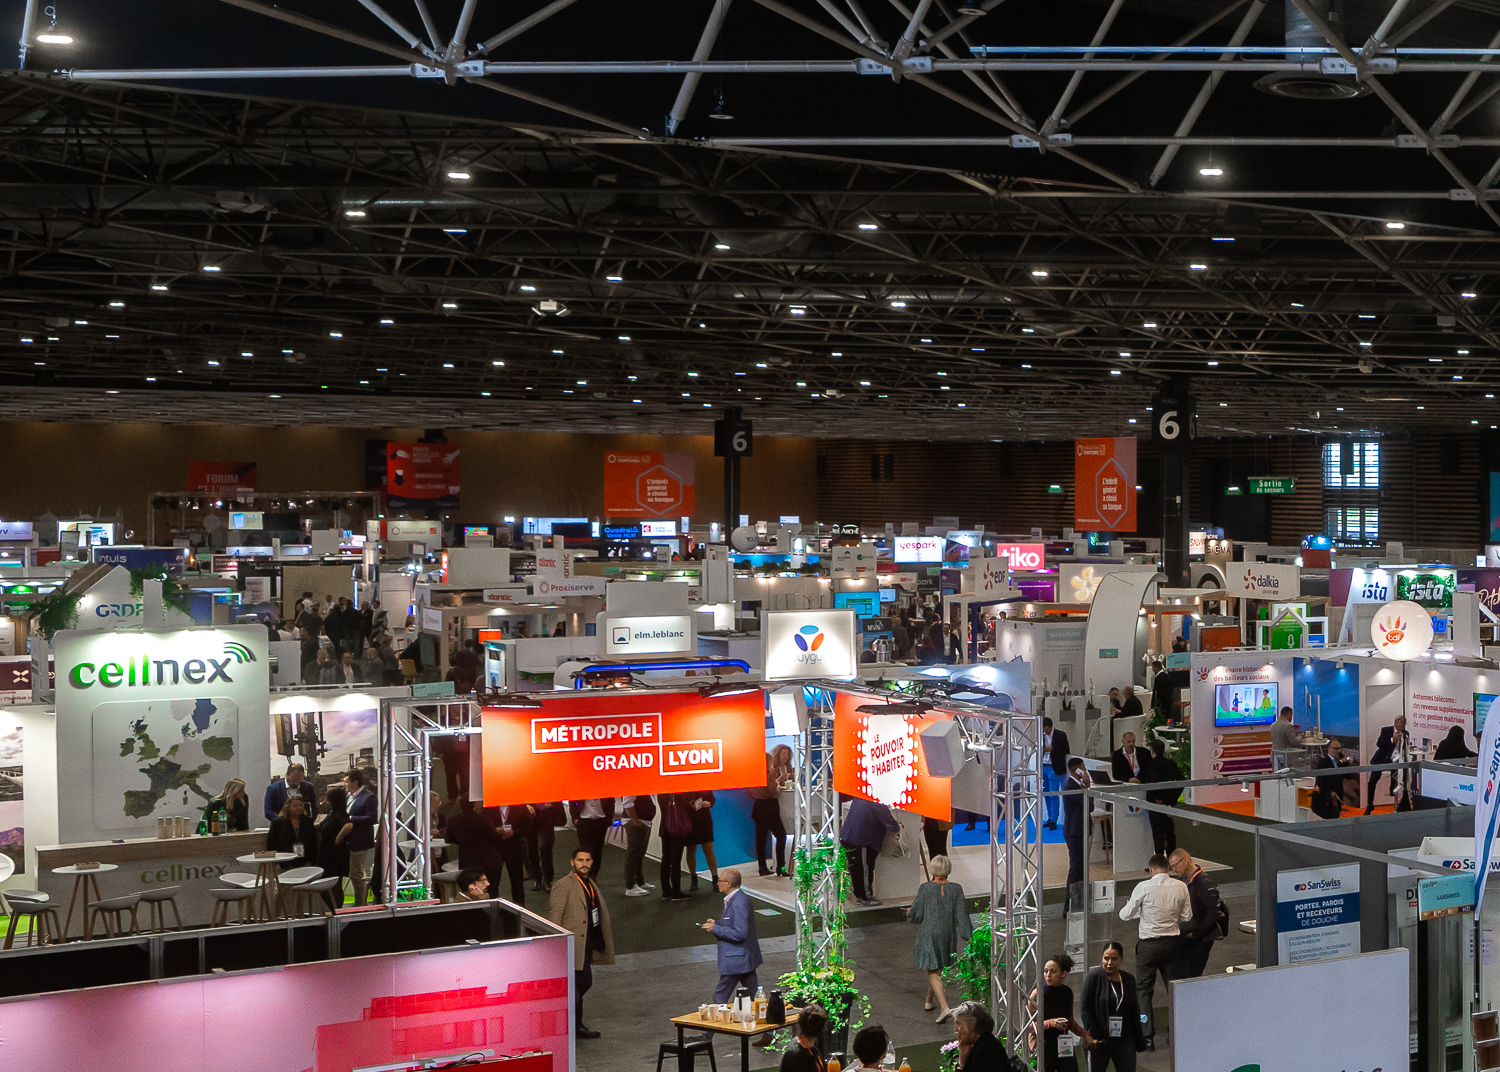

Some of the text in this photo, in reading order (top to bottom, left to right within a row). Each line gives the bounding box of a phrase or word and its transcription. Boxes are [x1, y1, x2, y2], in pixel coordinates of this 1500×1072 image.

[1159, 410, 1180, 440] 6
[732, 431, 748, 451] 6
[206, 474, 238, 484] FORUM
[1207, 546, 1232, 555] SIGMA
[1001, 547, 1040, 567] tiko
[550, 582, 595, 592] Proxiserve
[1256, 575, 1280, 589] dalkia
[1362, 582, 1388, 601] ista
[1409, 581, 1444, 600] ista
[634, 630, 685, 639] elm.leblanc
[1387, 632, 1402, 642] tdf
[70, 653, 234, 689] cellnex
[1224, 674, 1248, 682] bailleurs
[1412, 692, 1433, 702] Antennes
[1421, 704, 1438, 712] revenus
[1427, 713, 1441, 723] gestion
[541, 715, 653, 744] MÉTROPOLE
[873, 734, 880, 744] LE
[870, 738, 904, 760] POUVOIR
[592, 747, 714, 771] GRAND LYON
[871, 757, 906, 776] D'HABITER
[1459, 783, 1474, 792] wedi
[140, 861, 228, 885] cellnex
[1307, 878, 1342, 890] SanSwiss
[1322, 899, 1344, 908] PAROIS
[1296, 907, 1343, 919] ET RECEVEURS
[1301, 915, 1339, 927] DE DOUCHE
